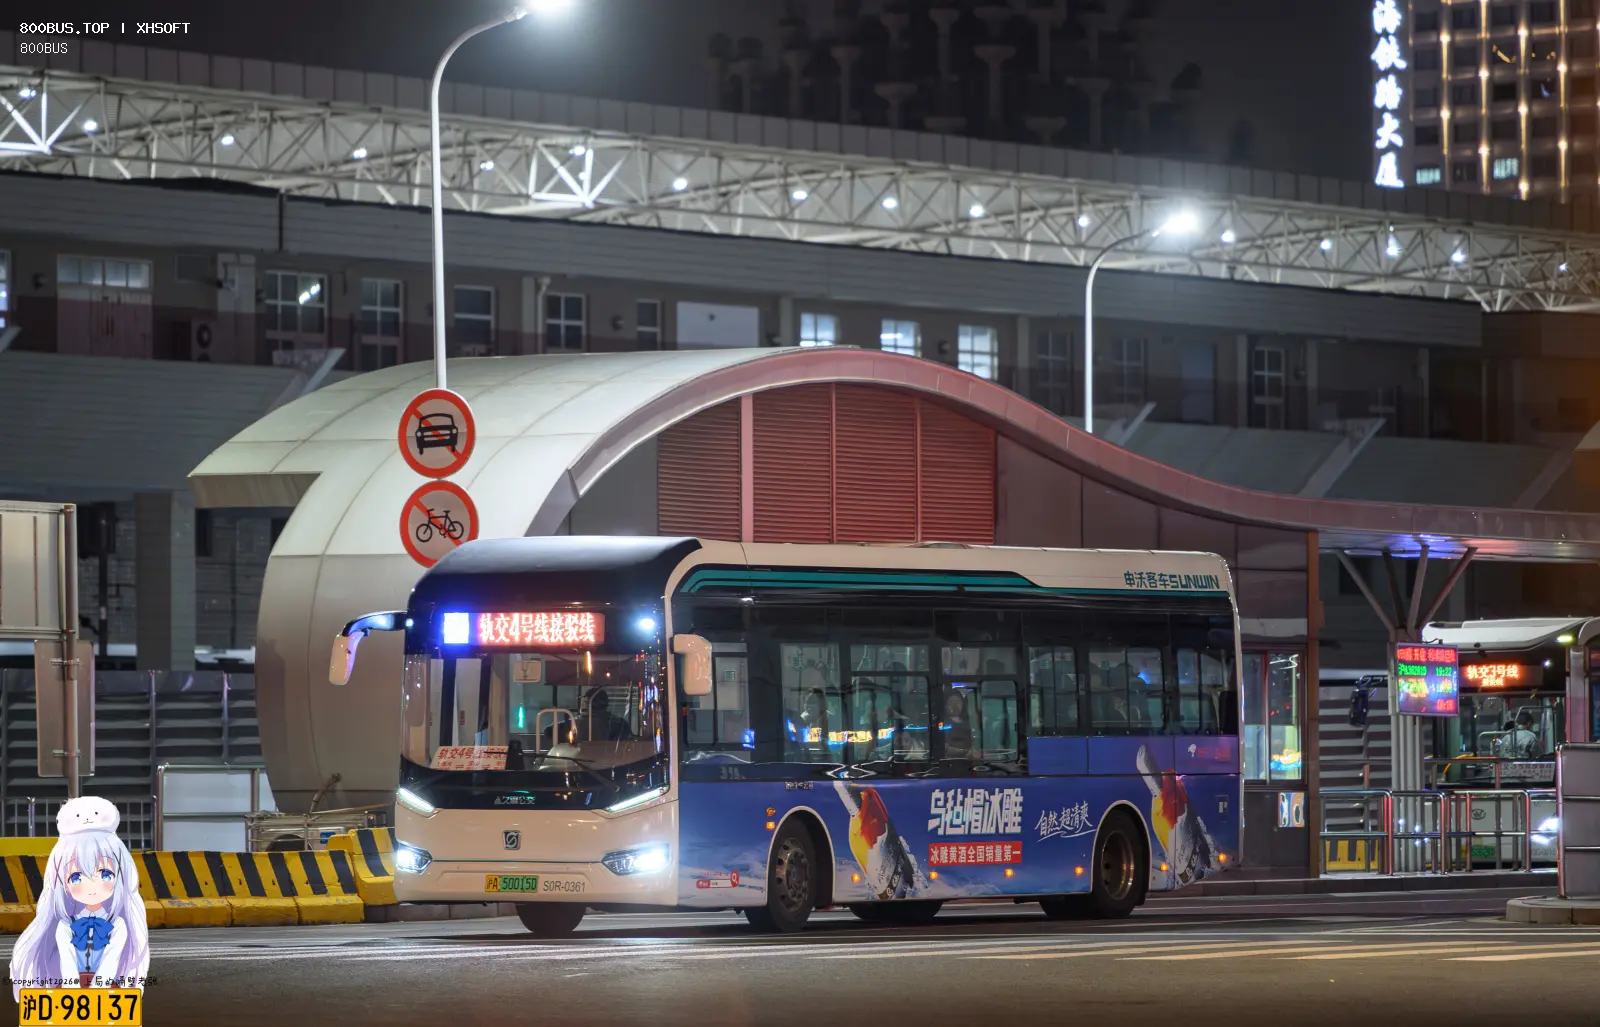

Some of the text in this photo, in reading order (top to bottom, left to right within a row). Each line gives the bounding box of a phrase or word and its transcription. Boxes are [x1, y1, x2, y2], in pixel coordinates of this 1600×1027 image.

[479, 612, 595, 643] 轨交4号线接驳线
[1467, 663, 1519, 680] 轨交3号线
[927, 787, 1024, 835] 乌毡帽冰雕
[930, 844, 1021, 864] 冰雕黄酒全国销量第一
